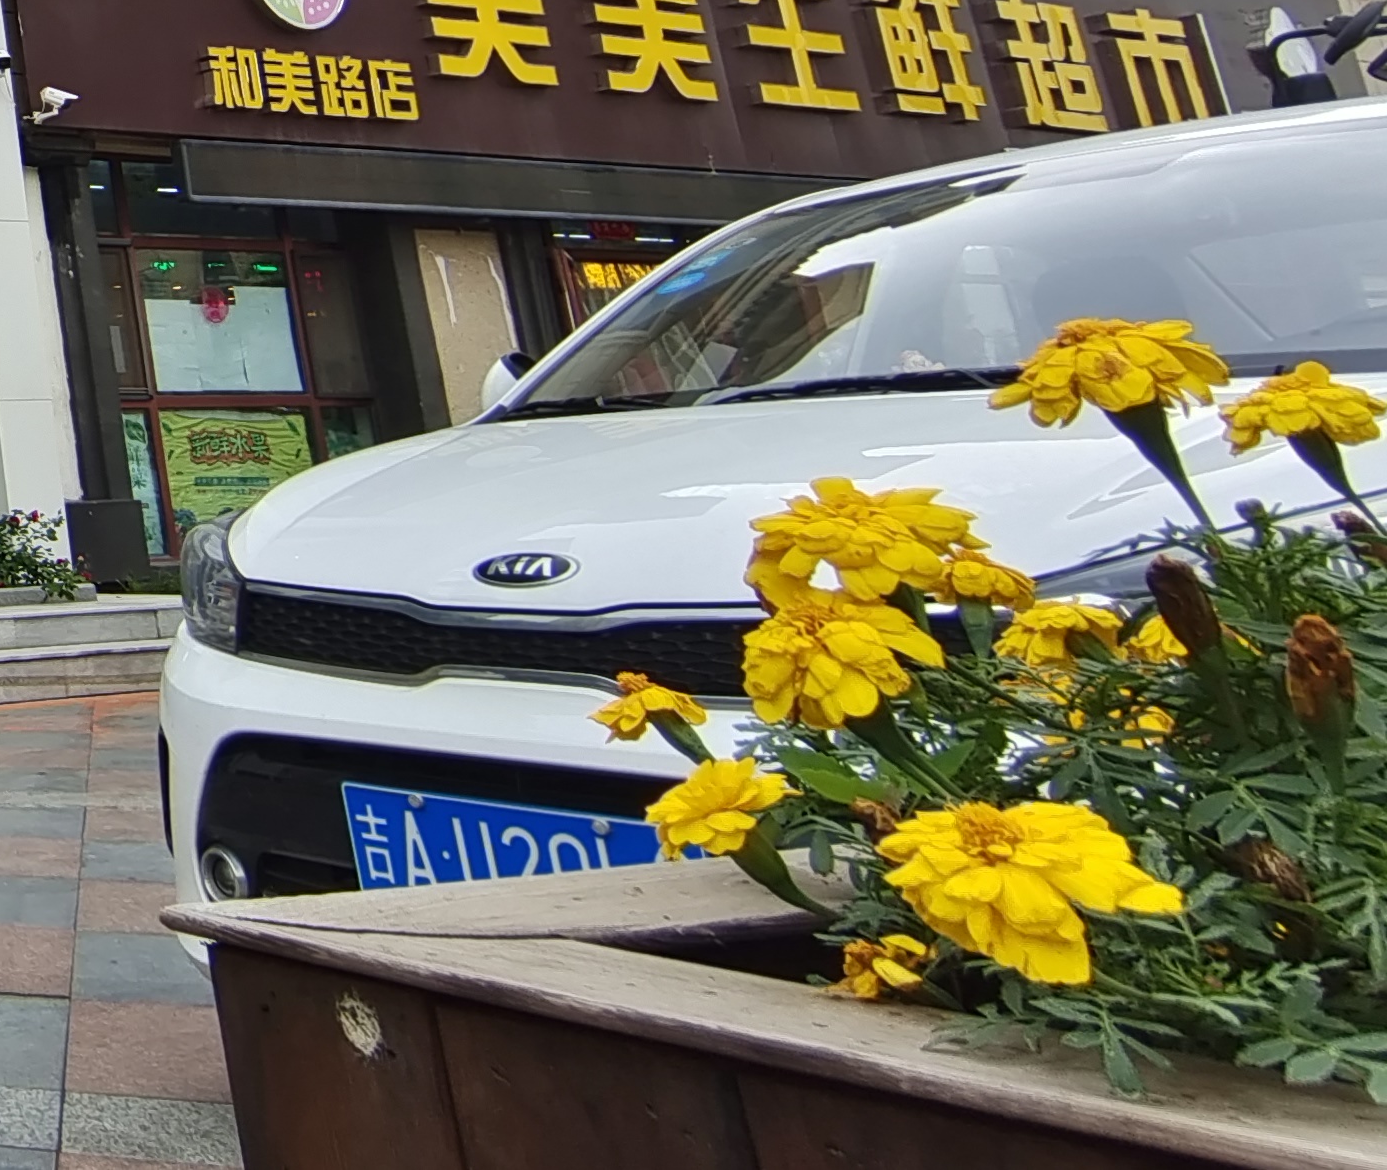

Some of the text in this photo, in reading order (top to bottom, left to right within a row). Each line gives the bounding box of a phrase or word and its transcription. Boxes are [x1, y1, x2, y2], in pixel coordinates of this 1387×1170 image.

[206, 45, 419, 122] 和美路店
[190, 432, 270, 458] 新鲜水果
[487, 555, 555, 578] KIA
